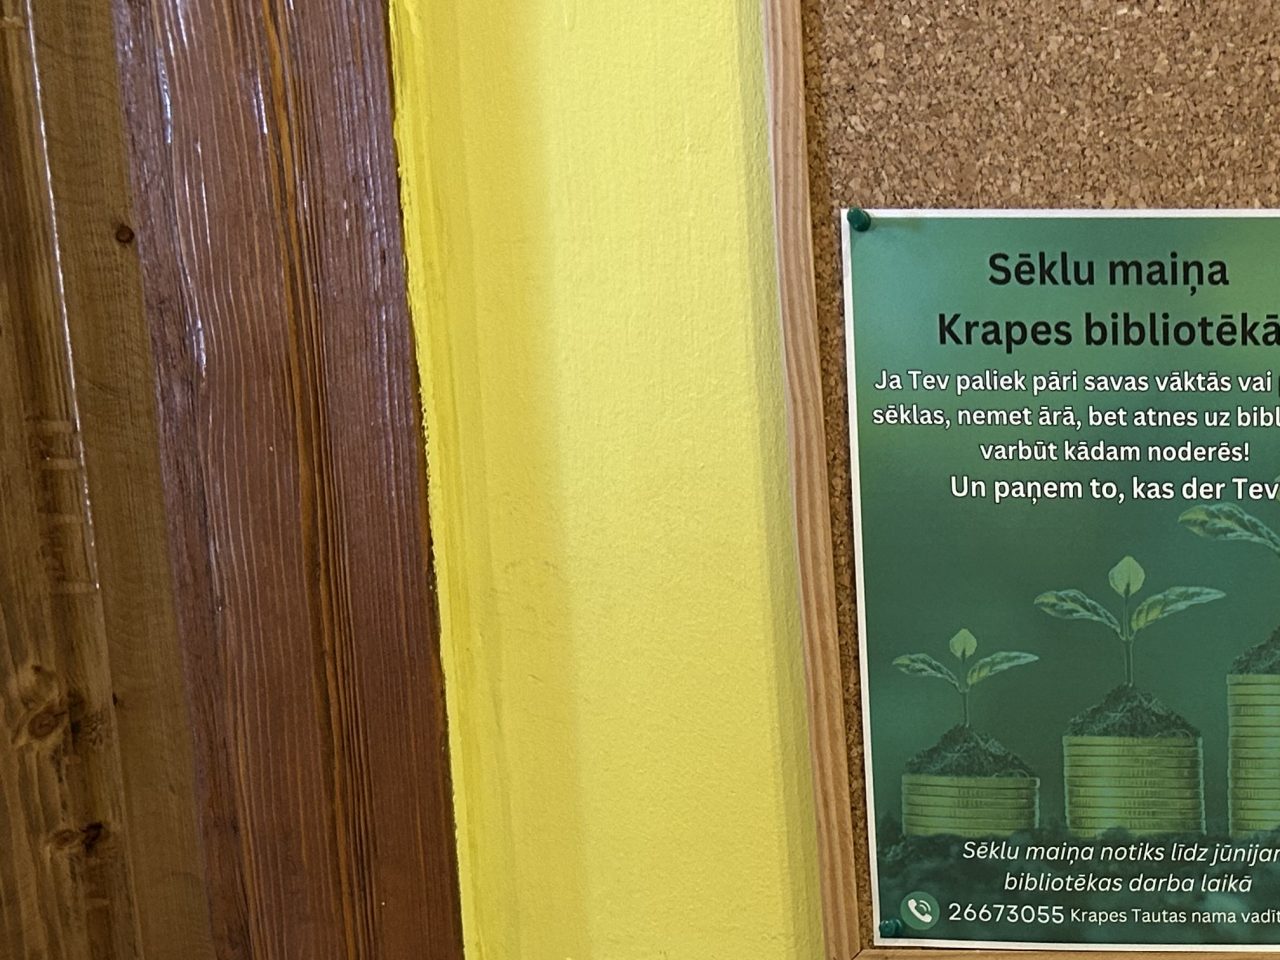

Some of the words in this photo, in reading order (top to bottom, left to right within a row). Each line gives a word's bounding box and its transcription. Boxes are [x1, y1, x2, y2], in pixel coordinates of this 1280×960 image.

[988, 251, 1095, 286] Sēklu
[1108, 253, 1229, 296] maiņa
[938, 313, 1073, 354] Krapes
[874, 369, 903, 391] Ja
[908, 369, 950, 391] Tev
[956, 369, 1027, 396] paliek
[1032, 369, 1077, 396] pāri
[1084, 373, 1150, 392] savas
[1155, 369, 1232, 393] vāktās
[1238, 371, 1272, 393] vai
[872, 404, 951, 430] sēklas,
[957, 408, 1032, 427] nemet
[1038, 406, 1082, 431] ārā,
[1088, 405, 1127, 428] bet
[1133, 408, 1198, 428] atnes
[1204, 410, 1231, 428] uz
[980, 438, 1057, 462] varbūt
[1064, 439, 1141, 462] kādam
[1147, 440, 1250, 463] noderēs!
[950, 476, 987, 498] Un
[993, 481, 1083, 505] paņem
[1089, 478, 1125, 504] to,
[1132, 476, 1175, 500] kas
[1181, 476, 1225, 500] der
[962, 841, 1019, 861] Sēklu
[1026, 843, 1094, 866] maiņa
[1100, 843, 1165, 862] notiks
[1171, 842, 1207, 863] līdz
[1004, 873, 1123, 893] bibliotēkas
[1128, 873, 1195, 894] darba
[1201, 874, 1253, 894] laikā
[948, 902, 1064, 924] 26673055
[1070, 909, 1127, 927] Krapes
[1132, 909, 1186, 925] Tautas
[1191, 911, 1236, 925] nama
